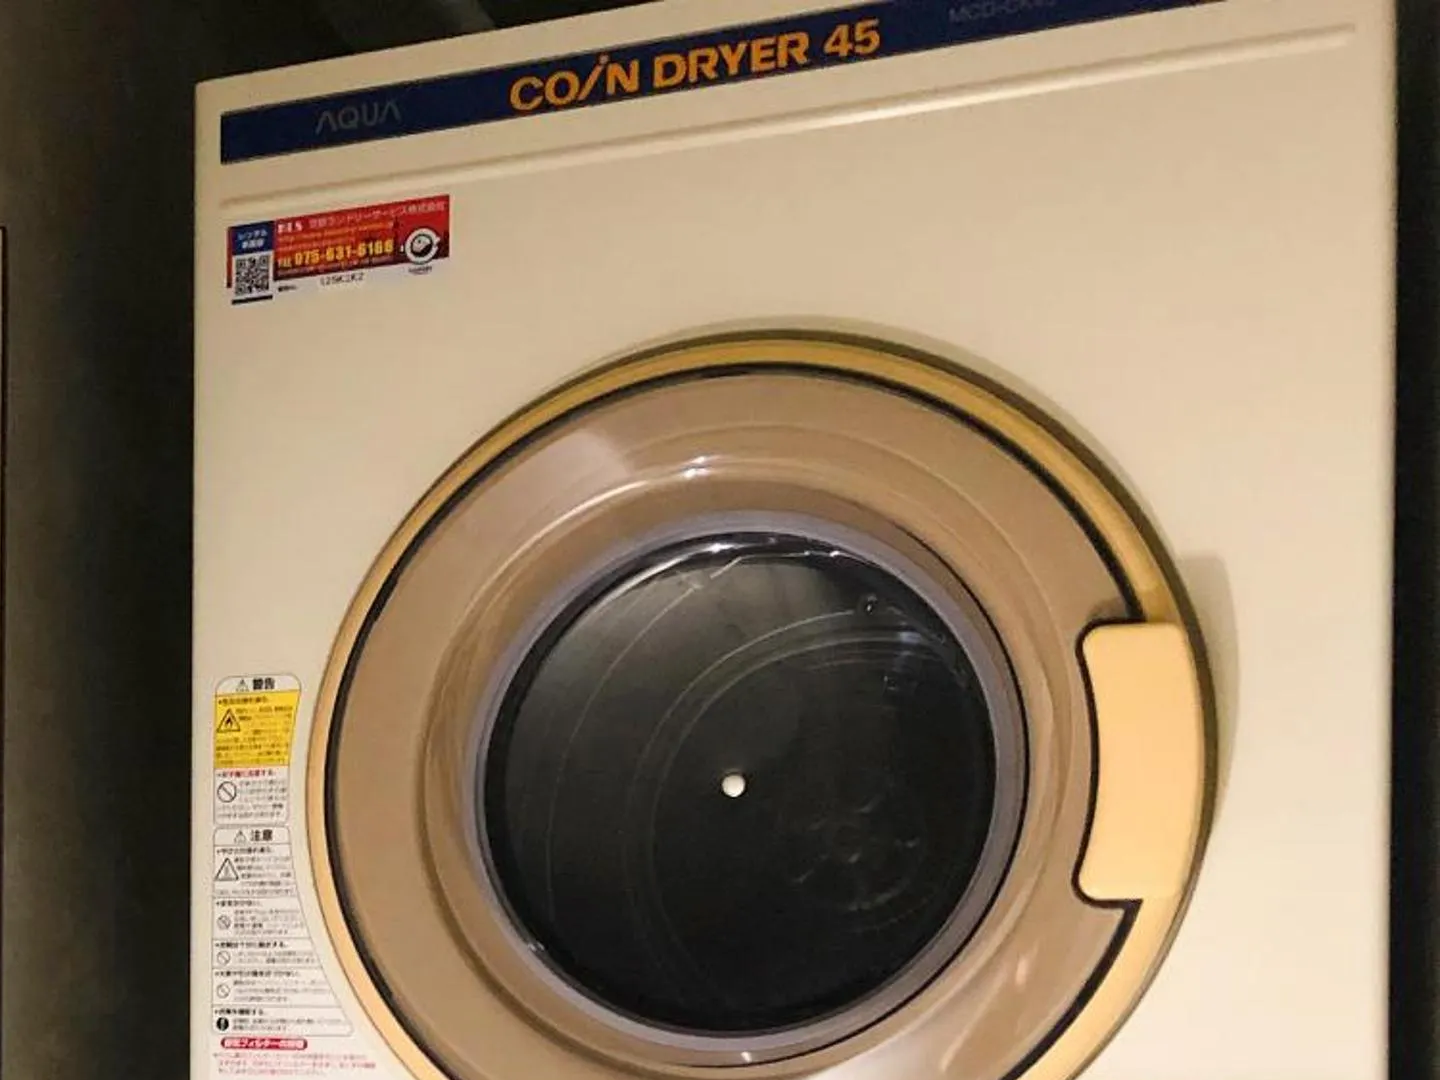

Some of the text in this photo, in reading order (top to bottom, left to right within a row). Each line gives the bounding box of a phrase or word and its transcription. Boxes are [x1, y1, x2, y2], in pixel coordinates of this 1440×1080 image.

[652, 31, 809, 88] DRYER
[822, 20, 881, 57] 45
[315, 100, 402, 134] AQUA
